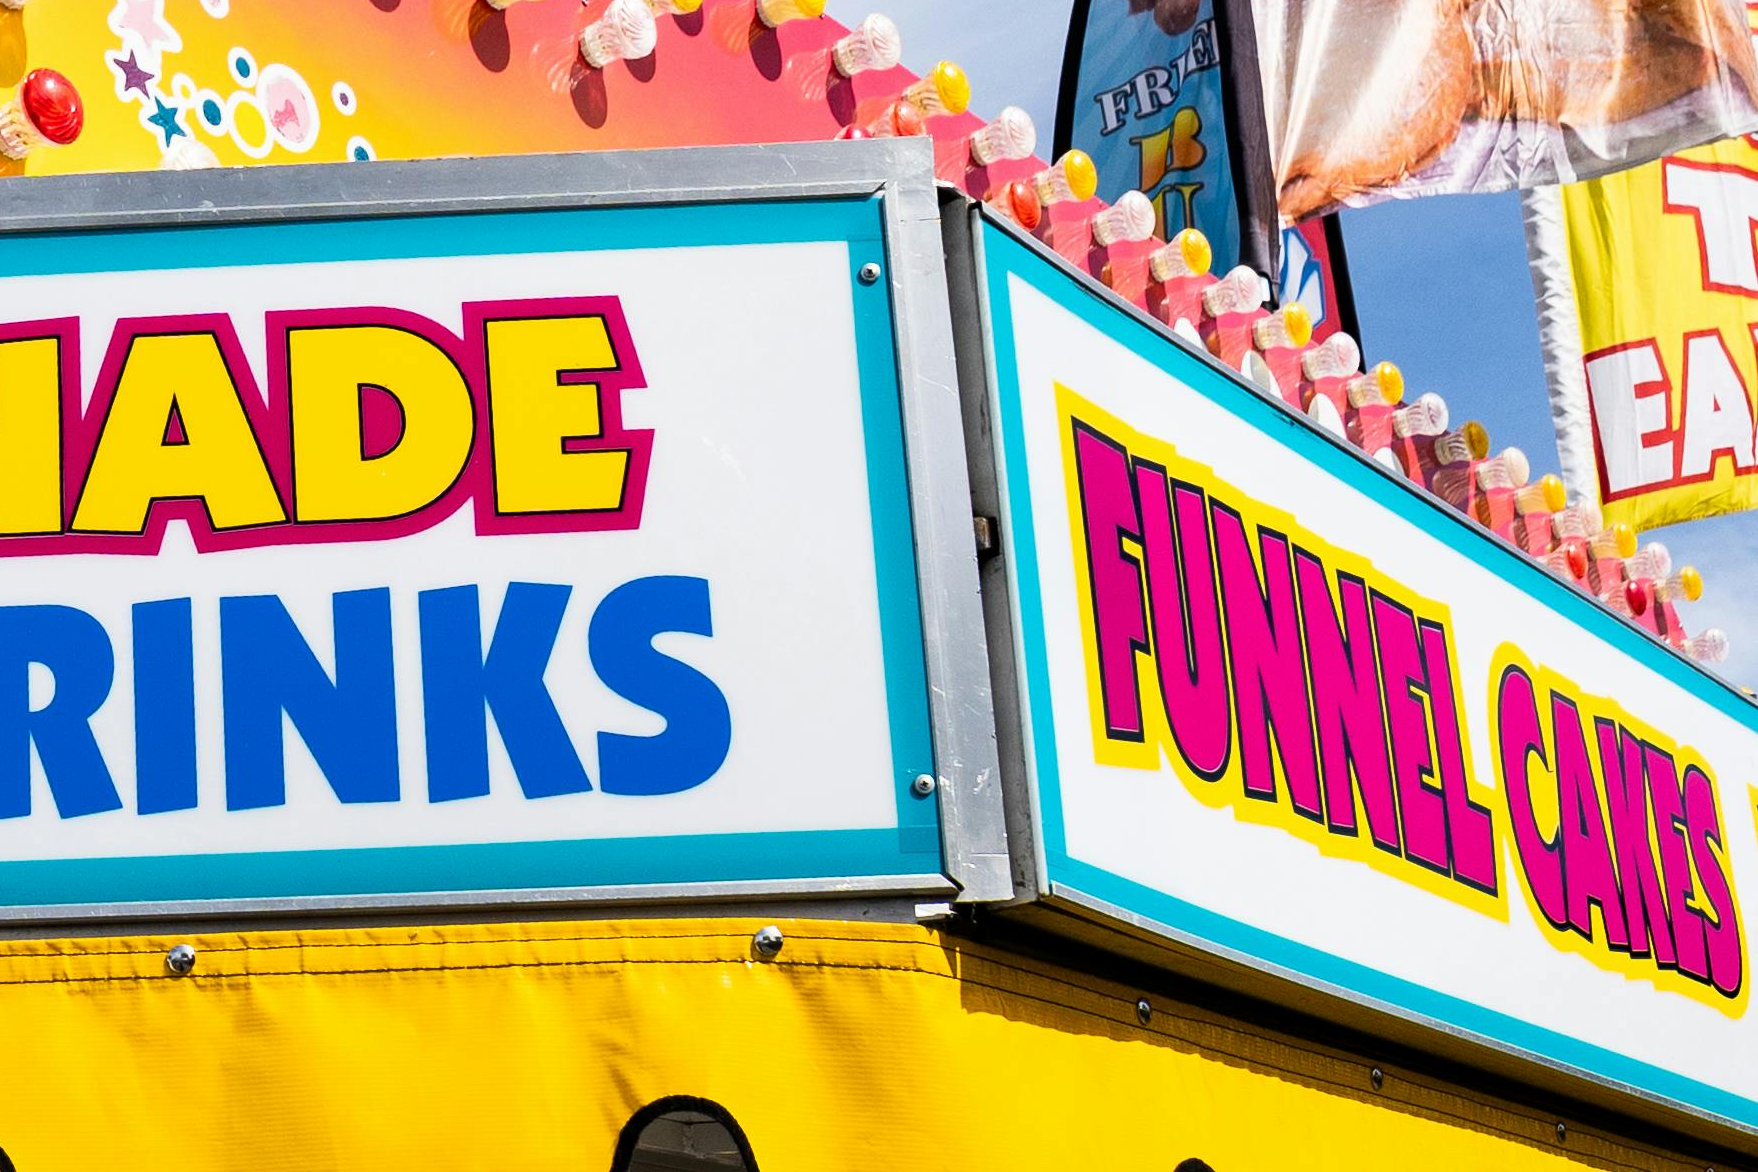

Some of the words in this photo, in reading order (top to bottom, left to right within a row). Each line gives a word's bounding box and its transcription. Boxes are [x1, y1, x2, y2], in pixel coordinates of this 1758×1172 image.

[1095, 18, 1220, 137] FRIE
[1071, 415, 1499, 897] FUNNEL
[1497, 663, 1743, 999] CAKES
